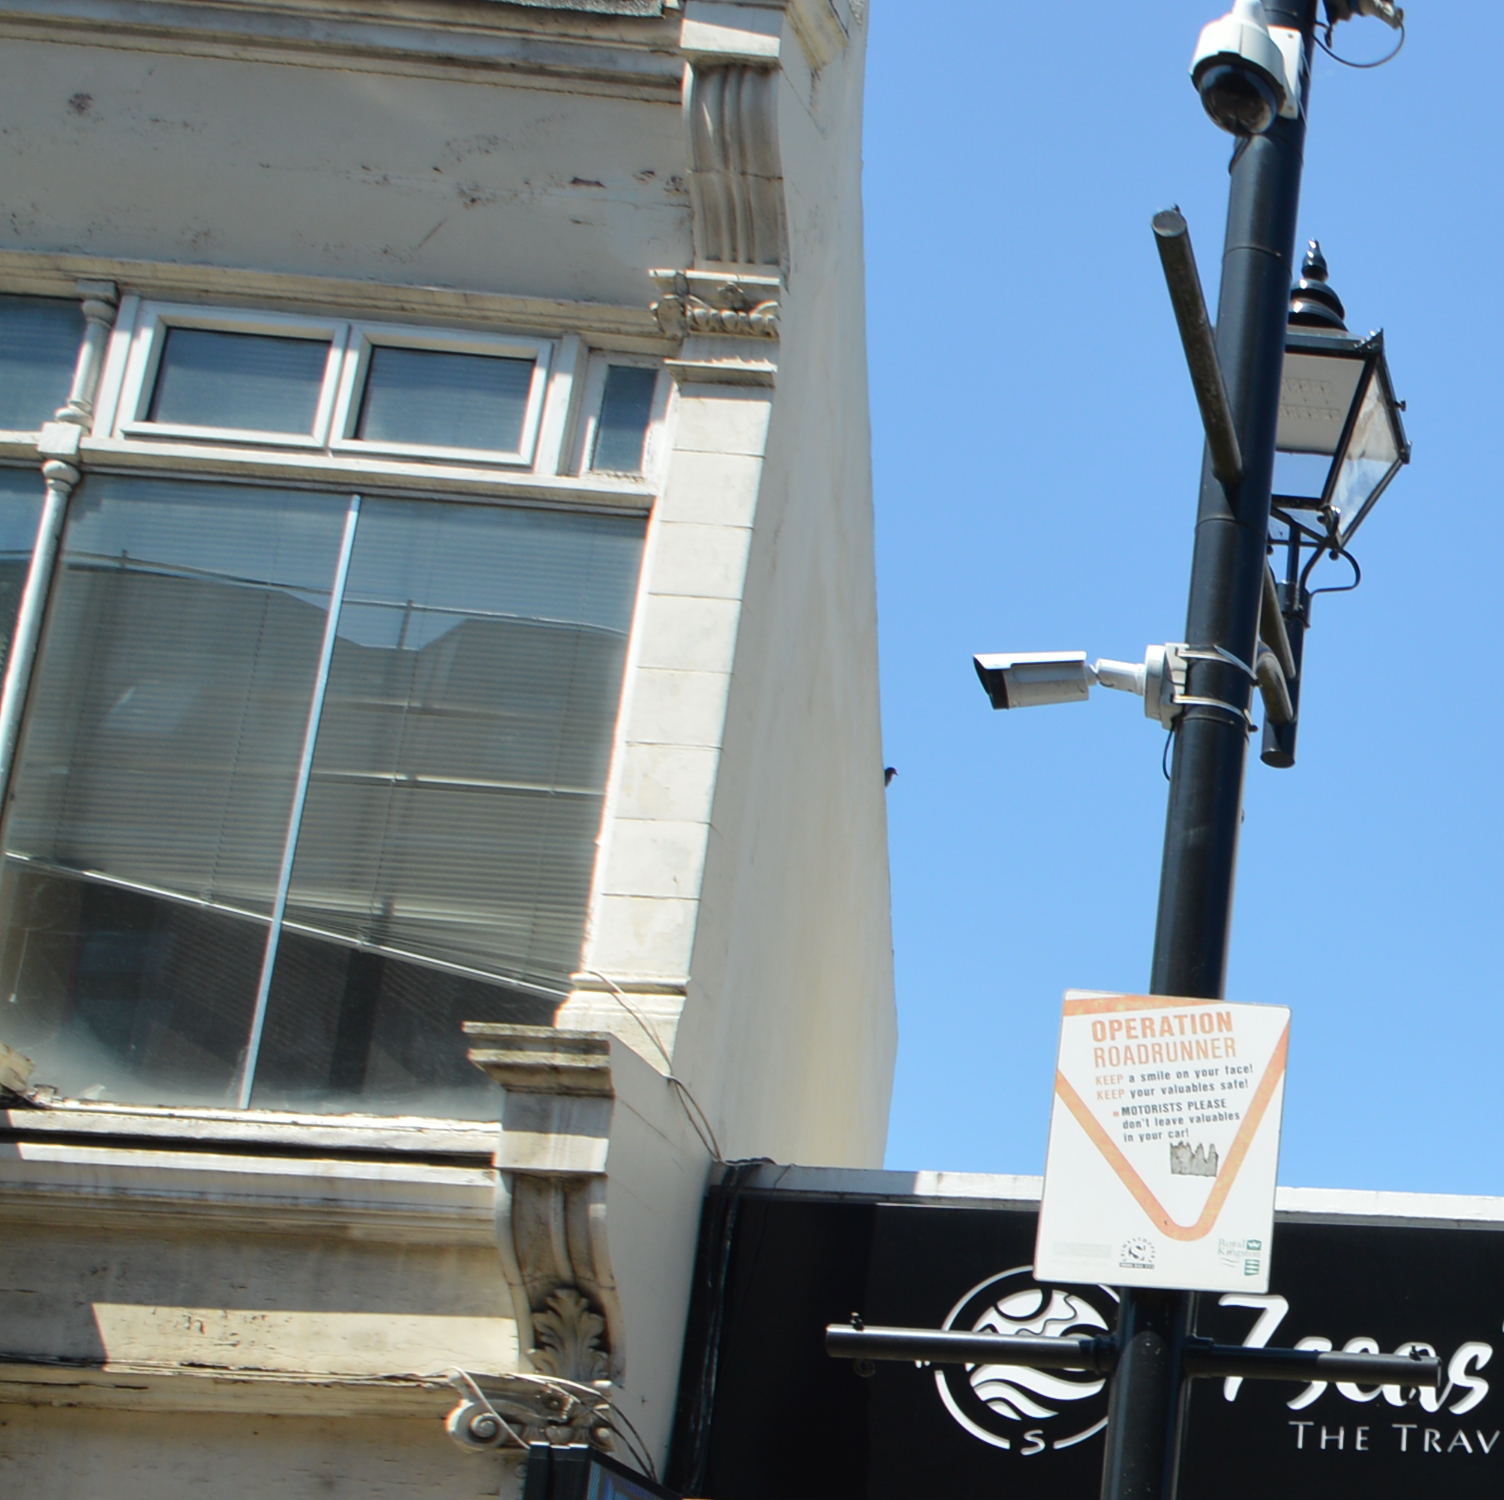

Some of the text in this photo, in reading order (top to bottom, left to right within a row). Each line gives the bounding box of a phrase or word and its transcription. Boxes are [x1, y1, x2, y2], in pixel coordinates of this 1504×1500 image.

[1092, 1011, 1233, 1042] OPERATION
[1093, 1037, 1236, 1068] ROADRUNNER
[1095, 1063, 1254, 1086] KEEP a smile on your face!
[1096, 1079, 1249, 1101] KEEP your valuables safe!
[1121, 1098, 1228, 1117] MOTORISTS PLEASE
[1122, 1110, 1241, 1130] don't leave valuables
[1123, 1127, 1190, 1143] in your car!
[1217, 1247, 1261, 1259] Kingston
[1218, 1237, 1246, 1249] Royal
[1289, 1421, 1370, 1451] THE
